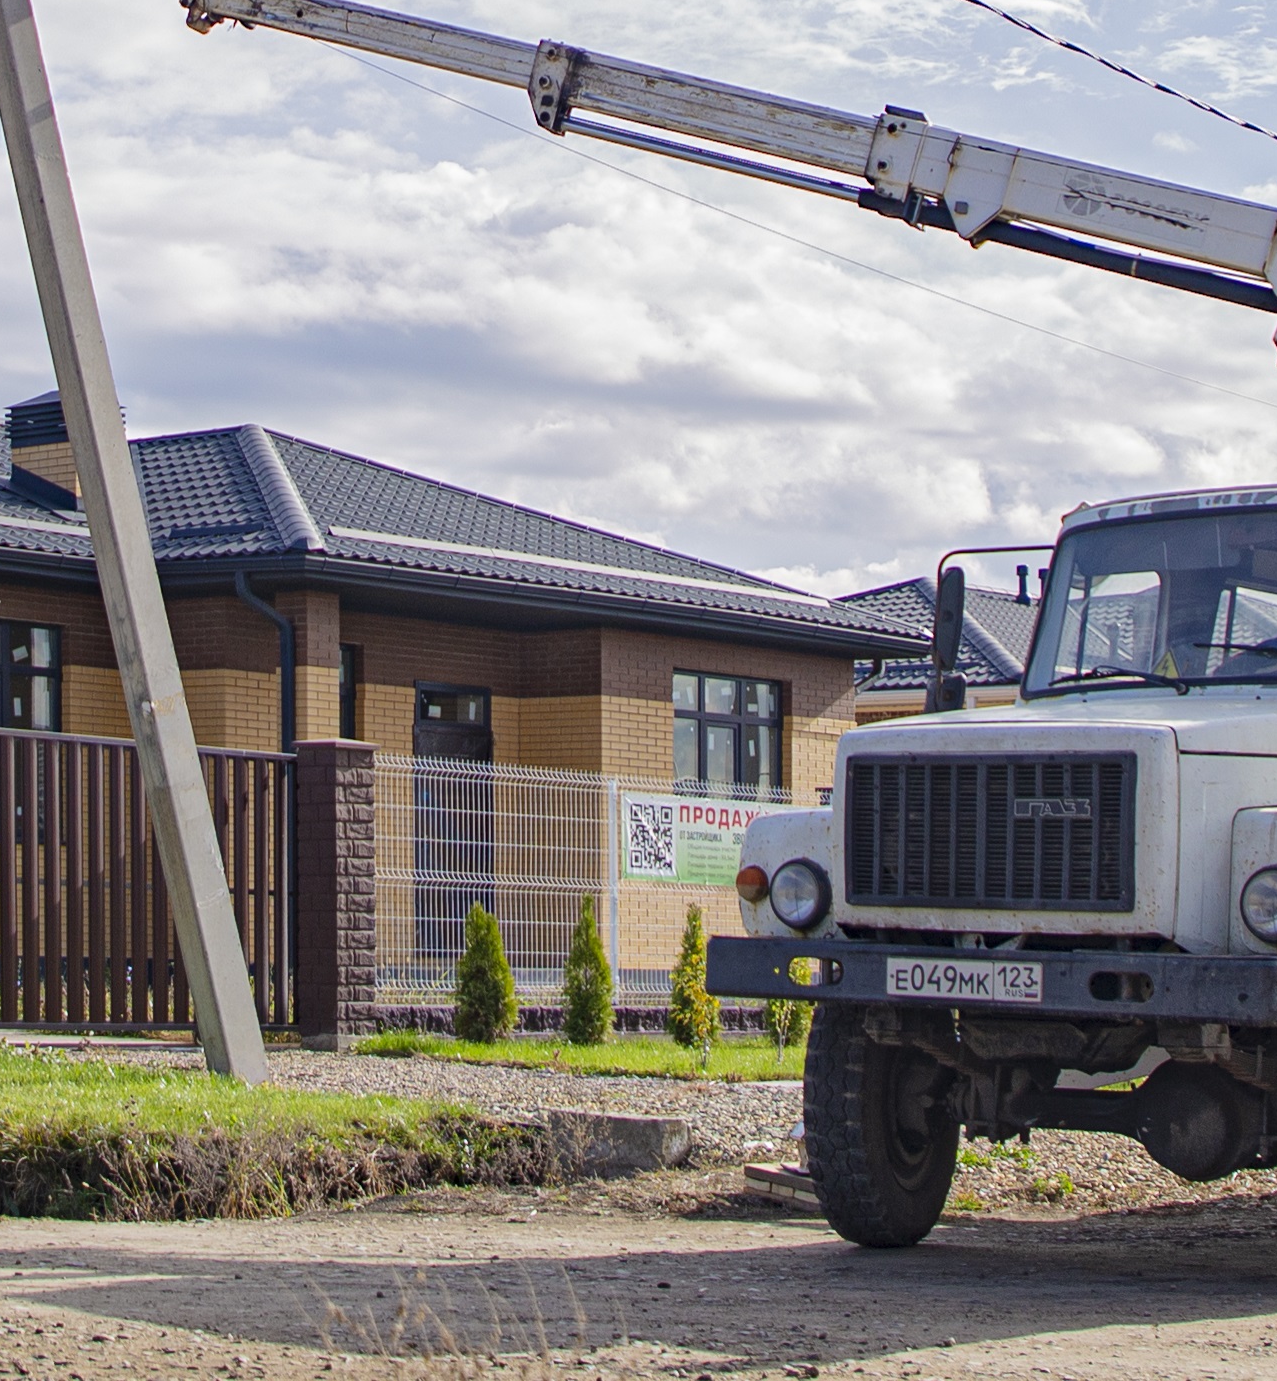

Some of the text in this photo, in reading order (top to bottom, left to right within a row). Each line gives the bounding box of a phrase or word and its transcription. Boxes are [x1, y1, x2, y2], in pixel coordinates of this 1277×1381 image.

[679, 805, 769, 830] ПРОДАЖ
[1014, 798, 1091, 817] ГАЗ
[997, 966, 1035, 988] 123
[1004, 989, 1024, 998] RUS
